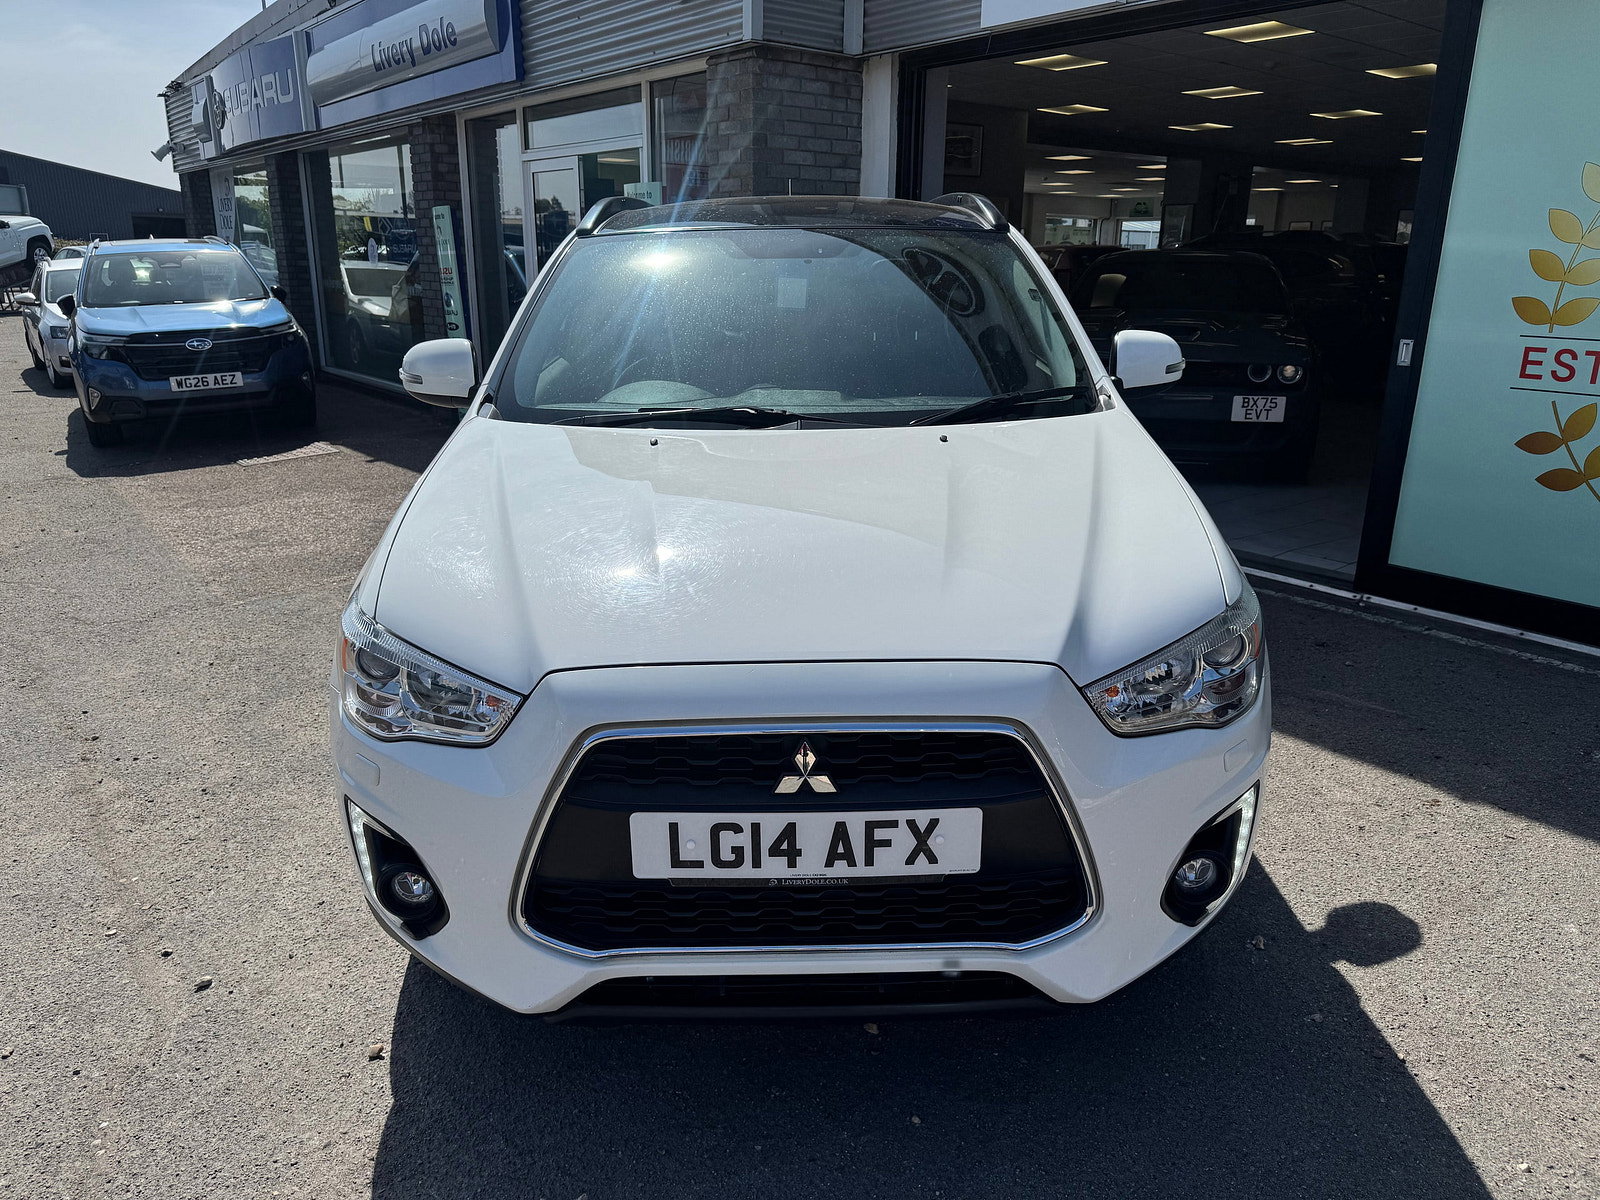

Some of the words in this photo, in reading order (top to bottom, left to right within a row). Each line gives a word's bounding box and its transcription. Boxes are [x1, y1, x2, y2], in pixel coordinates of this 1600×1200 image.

[371, 37, 417, 72] Livery
[419, 16, 458, 56] Dole
[222, 68, 294, 119] SUBARU
[175, 376, 210, 389] WG26
[213, 374, 237, 386] AEZ
[1519, 346, 1600, 385] EST
[1241, 396, 1278, 409] BX75
[1244, 408, 1272, 420] EVT
[668, 821, 803, 869] LG14
[824, 818, 940, 868] AFX
